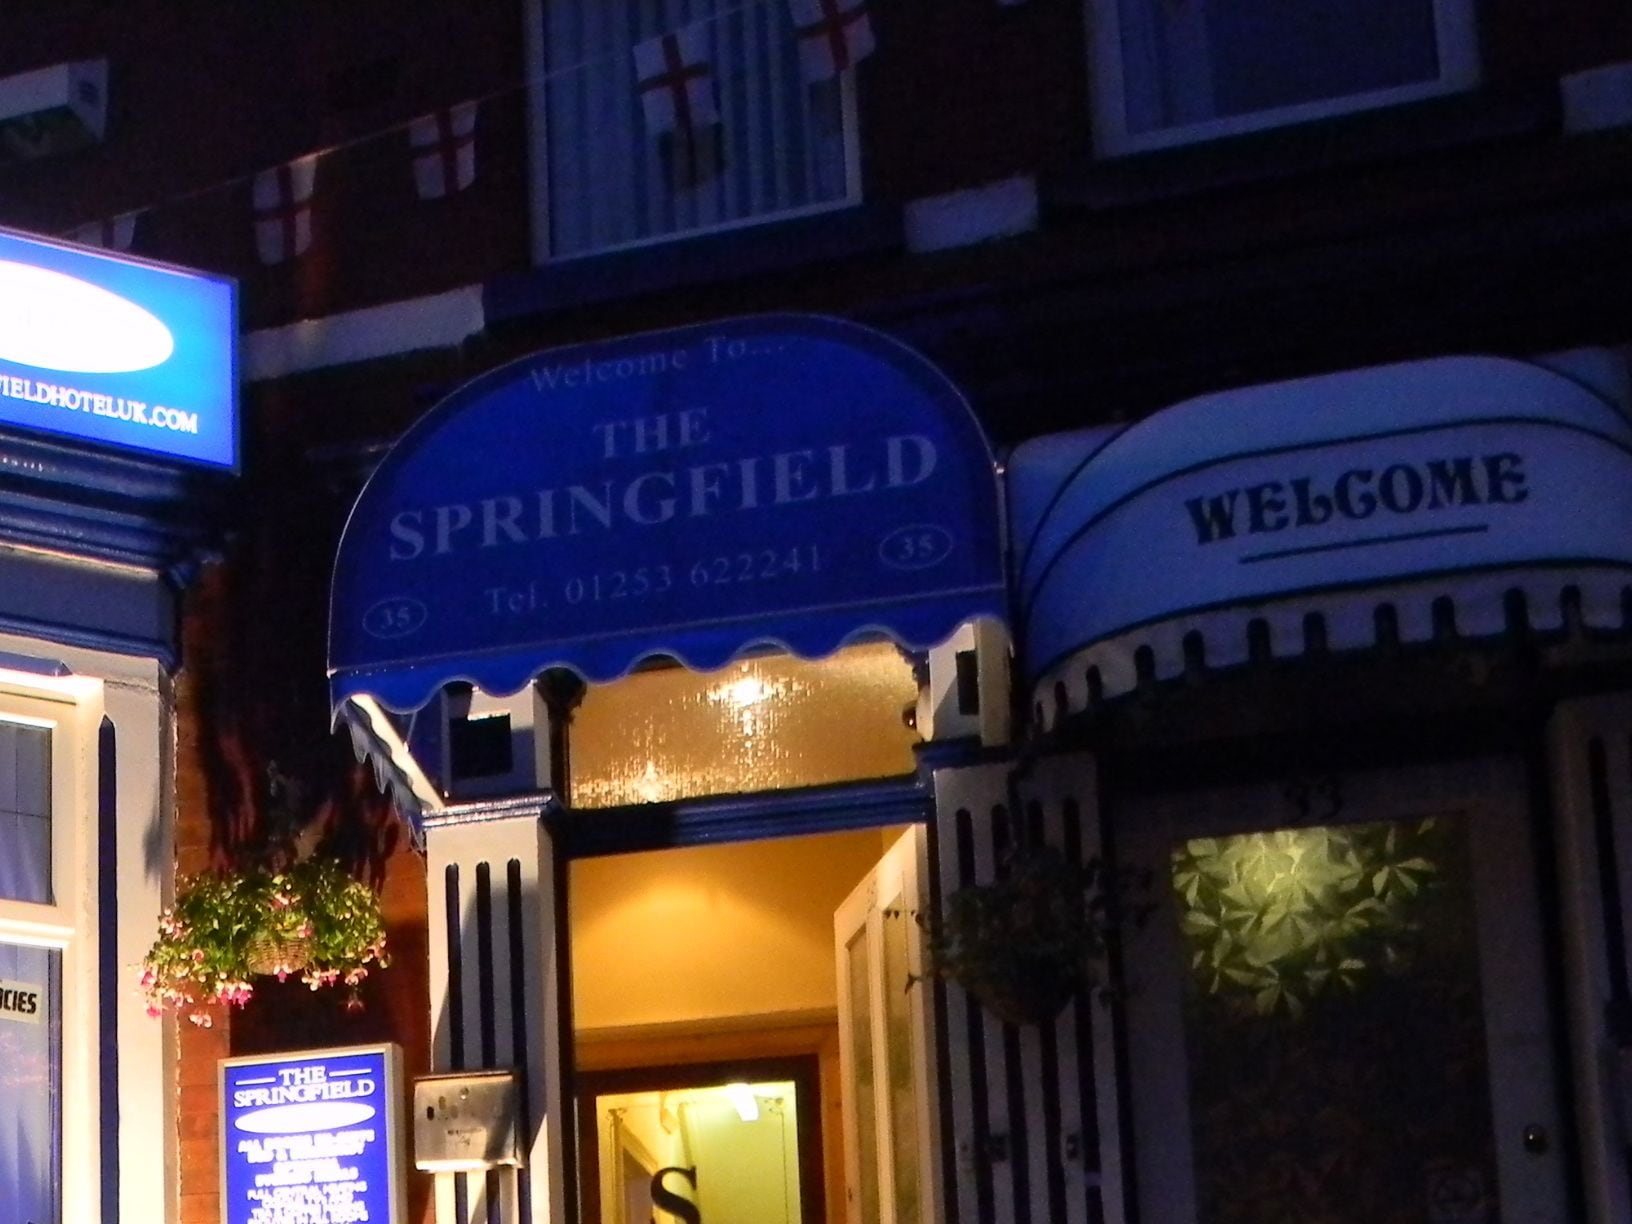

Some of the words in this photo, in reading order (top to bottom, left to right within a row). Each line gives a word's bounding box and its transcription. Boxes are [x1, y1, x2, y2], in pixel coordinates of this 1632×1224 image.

[530, 349, 688, 392] Welcome
[594, 407, 711, 459] THE
[389, 434, 939, 561] SPRINGFIELD
[1184, 452, 1529, 545] WELCOME
[900, 534, 934, 560] 35
[484, 579, 549, 614] Tel.
[565, 565, 671, 604] 01253
[690, 542, 819, 588] 622241
[380, 606, 411, 630] 35
[234, 1079, 376, 1108] SPRINGFIELD
[278, 1066, 327, 1087] THE
